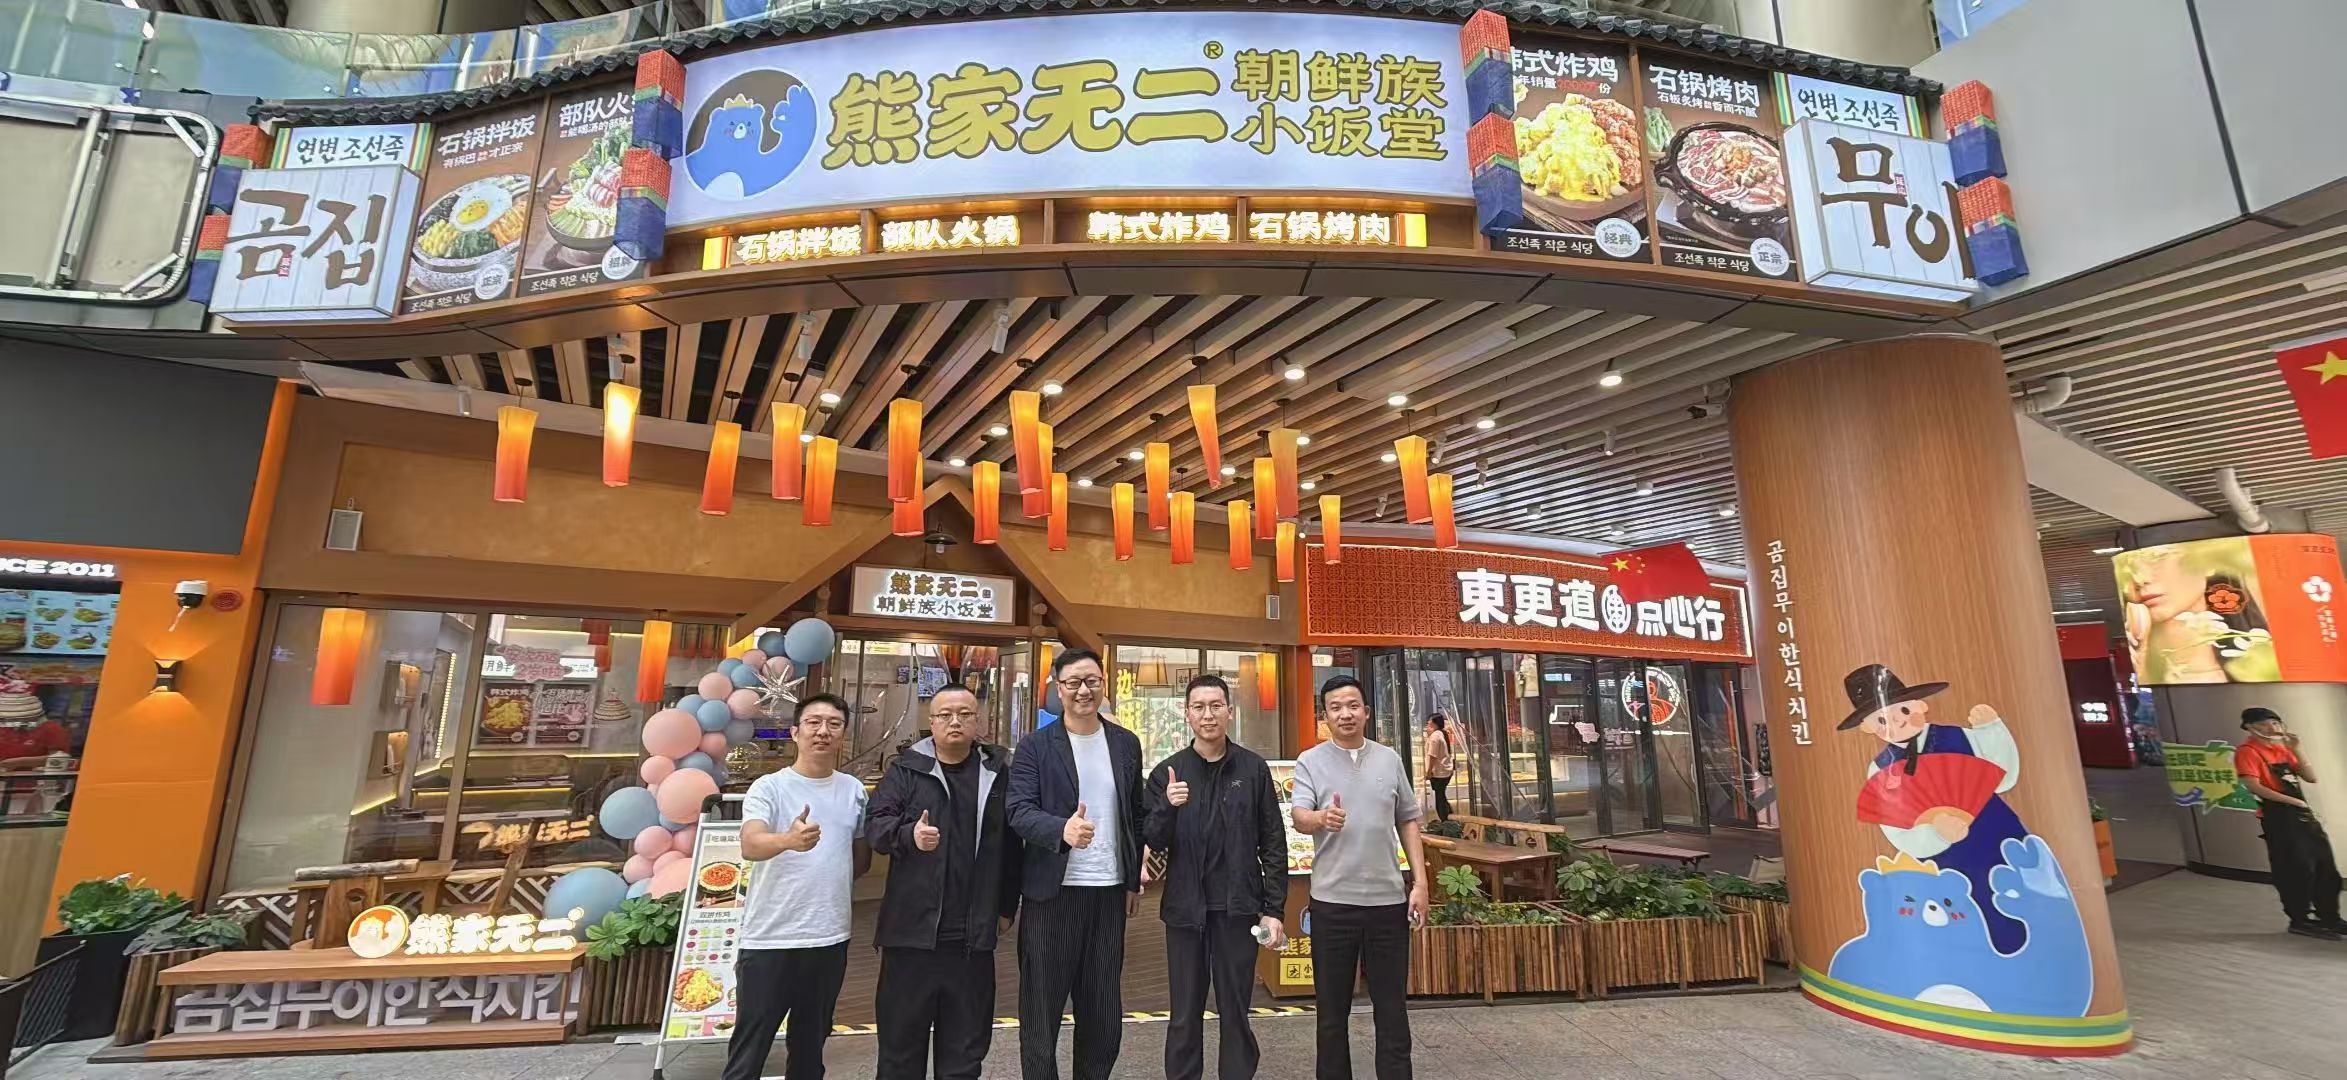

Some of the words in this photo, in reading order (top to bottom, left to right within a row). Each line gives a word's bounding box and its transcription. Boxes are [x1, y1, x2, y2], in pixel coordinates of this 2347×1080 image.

[1231, 48, 1448, 108] 朝鲜族
[1649, 64, 1760, 107] 石锅烤肉
[559, 92, 635, 128] 部队火
[821, 59, 1228, 170] 熊家无二
[1797, 88, 1839, 121] 연변
[1843, 97, 1900, 131] 조선족
[296, 136, 339, 164] 연변
[340, 134, 404, 162] 조선족
[438, 114, 537, 156] 石锅拌饭
[1231, 102, 1448, 160] 小饭堂
[224, 188, 387, 290] 곰집
[736, 225, 862, 264] 石锅拌饭
[881, 215, 1021, 251] 部队火锅
[1087, 211, 1230, 244] 韩式炸鸡
[1250, 210, 1390, 245] 石锅烤肉
[1507, 236, 1541, 250] 조선족
[1570, 241, 1594, 255] 식당
[1674, 252, 1704, 266] 조선족
[1729, 259, 1750, 272] 식당
[0, 558, 49, 574] CE
[49, 561, 115, 577] 2011
[889, 571, 979, 598] 熊家无二
[876, 596, 993, 618] 朝鲜族小饭堂
[1456, 567, 1600, 632] 東更道
[1636, 596, 1726, 641] 点心行
[1766, 540, 1812, 745] 곰집무이한식치킨
[404, 912, 578, 955] 熊家无二
